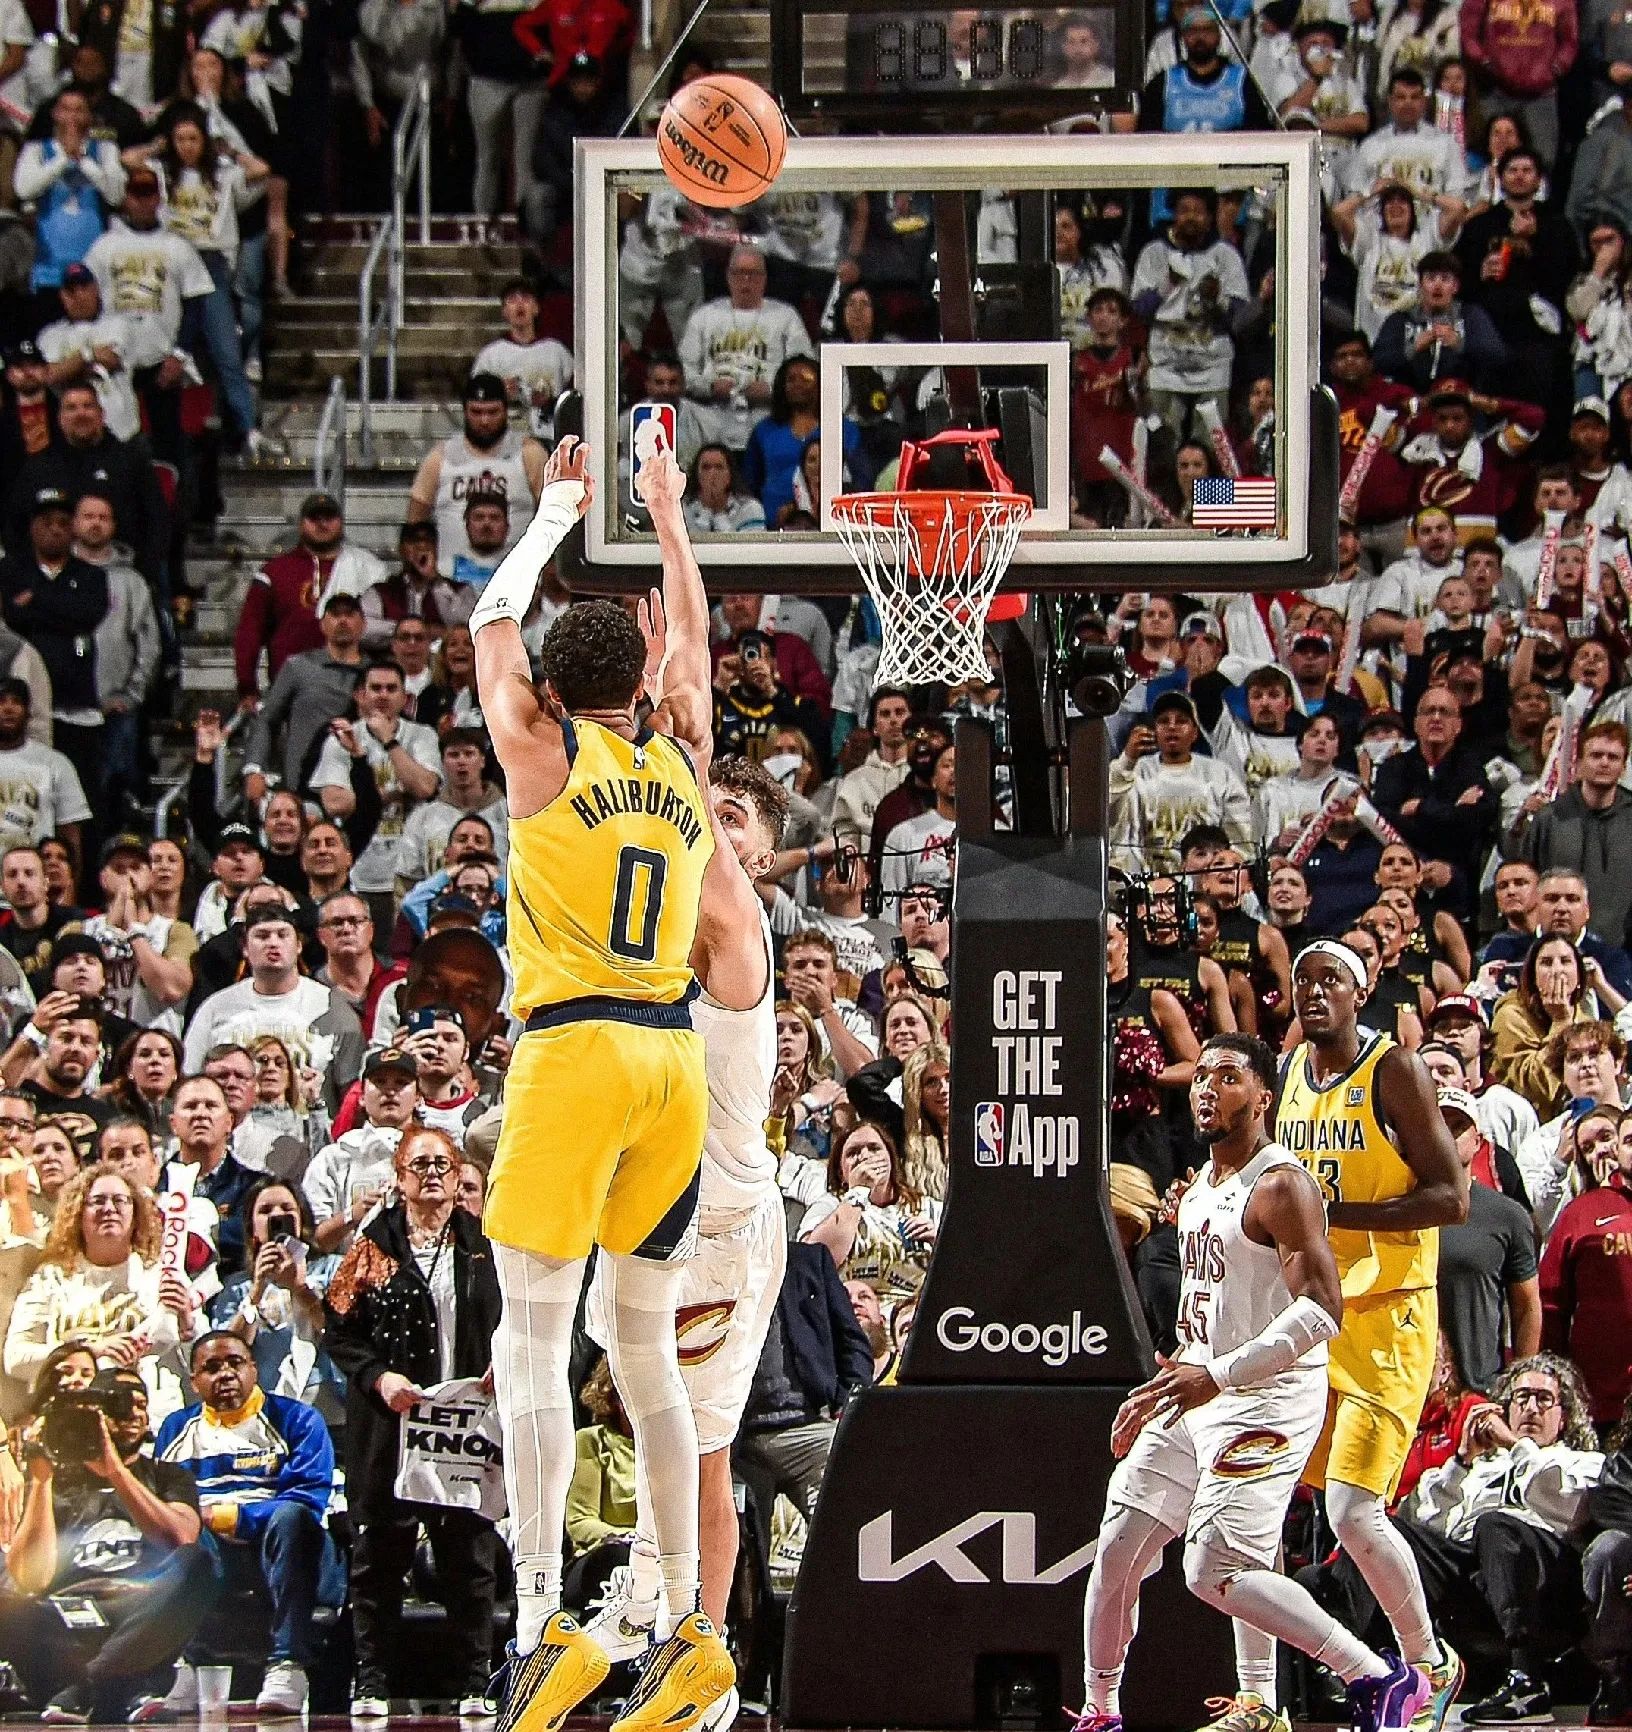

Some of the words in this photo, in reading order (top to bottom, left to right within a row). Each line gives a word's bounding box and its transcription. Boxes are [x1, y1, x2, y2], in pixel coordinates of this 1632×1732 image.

[665, 119, 730, 185] Wilson
[570, 779, 702, 851] HALIBURTON
[607, 843, 669, 963] 0
[992, 970, 1063, 1030] GET
[992, 1036, 1063, 1096] THE
[1008, 1103, 1079, 1177] App
[1279, 1119, 1366, 1151] INDIANA
[936, 1306, 1109, 1366] Google
[408, 1402, 476, 1428] LET
